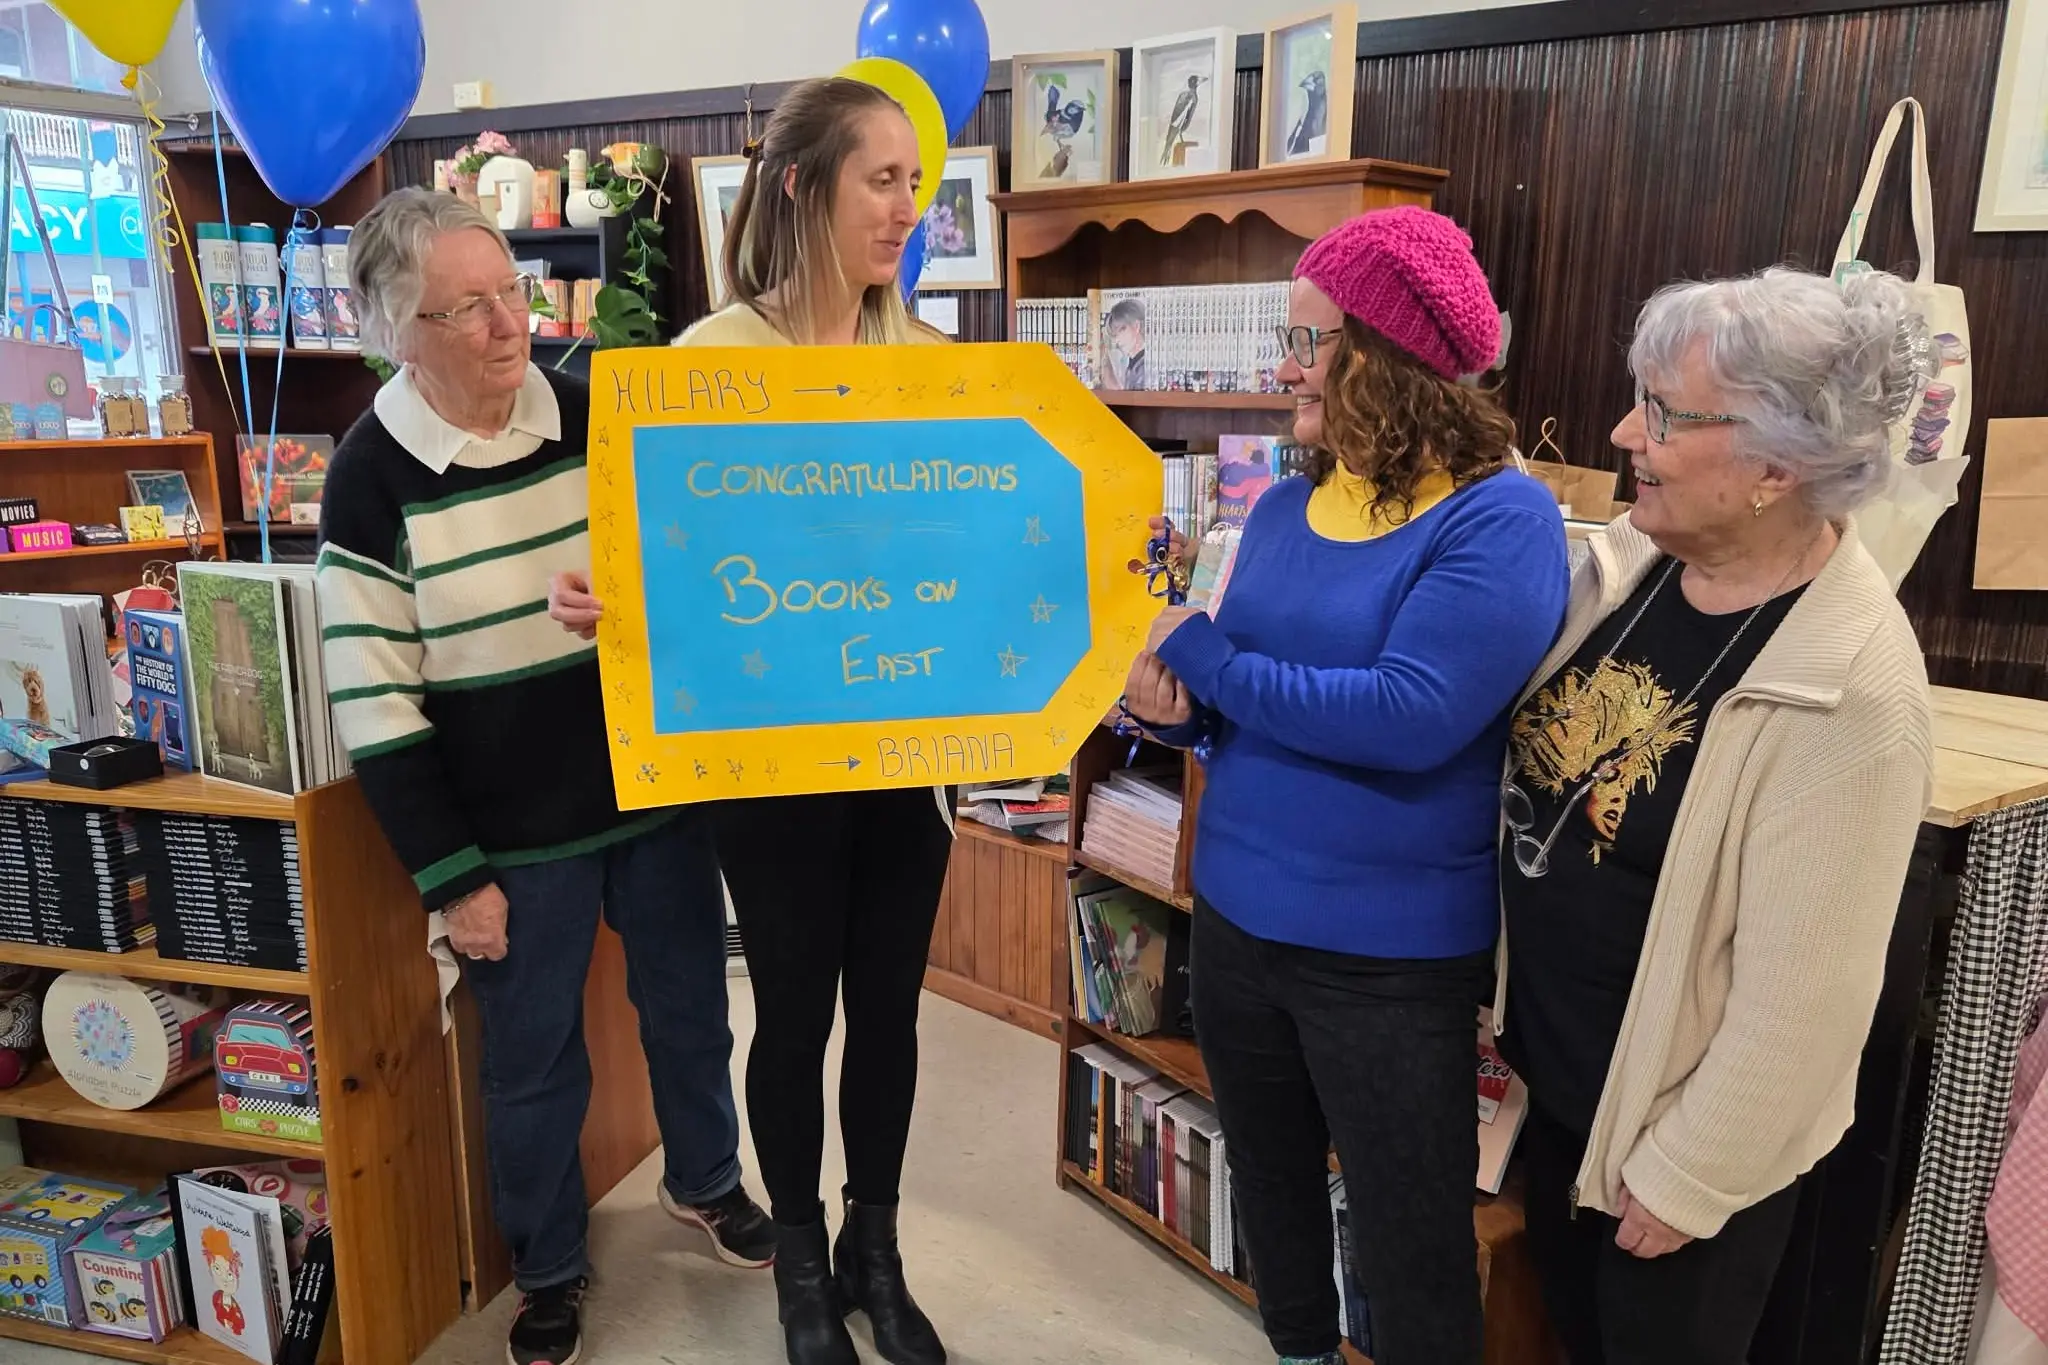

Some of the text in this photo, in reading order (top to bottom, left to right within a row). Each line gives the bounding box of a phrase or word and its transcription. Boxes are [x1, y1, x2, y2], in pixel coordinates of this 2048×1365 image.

[613, 368, 770, 414] HILARY
[686, 459, 1018, 499] CONGRATULATIONS
[0, 504, 35, 522] MOVIES
[21, 531, 65, 548] MUSIC
[135, 664, 148, 676] THE
[147, 667, 168, 680] WORLD
[143, 658, 165, 672] HISTORY
[166, 663, 175, 673] OF
[136, 673, 177, 695] FIFTY DOGS
[878, 733, 1014, 777] BRIANA
[235, 1117, 309, 1136] CARS PUZZLE
[82, 1258, 144, 1284] Counting
